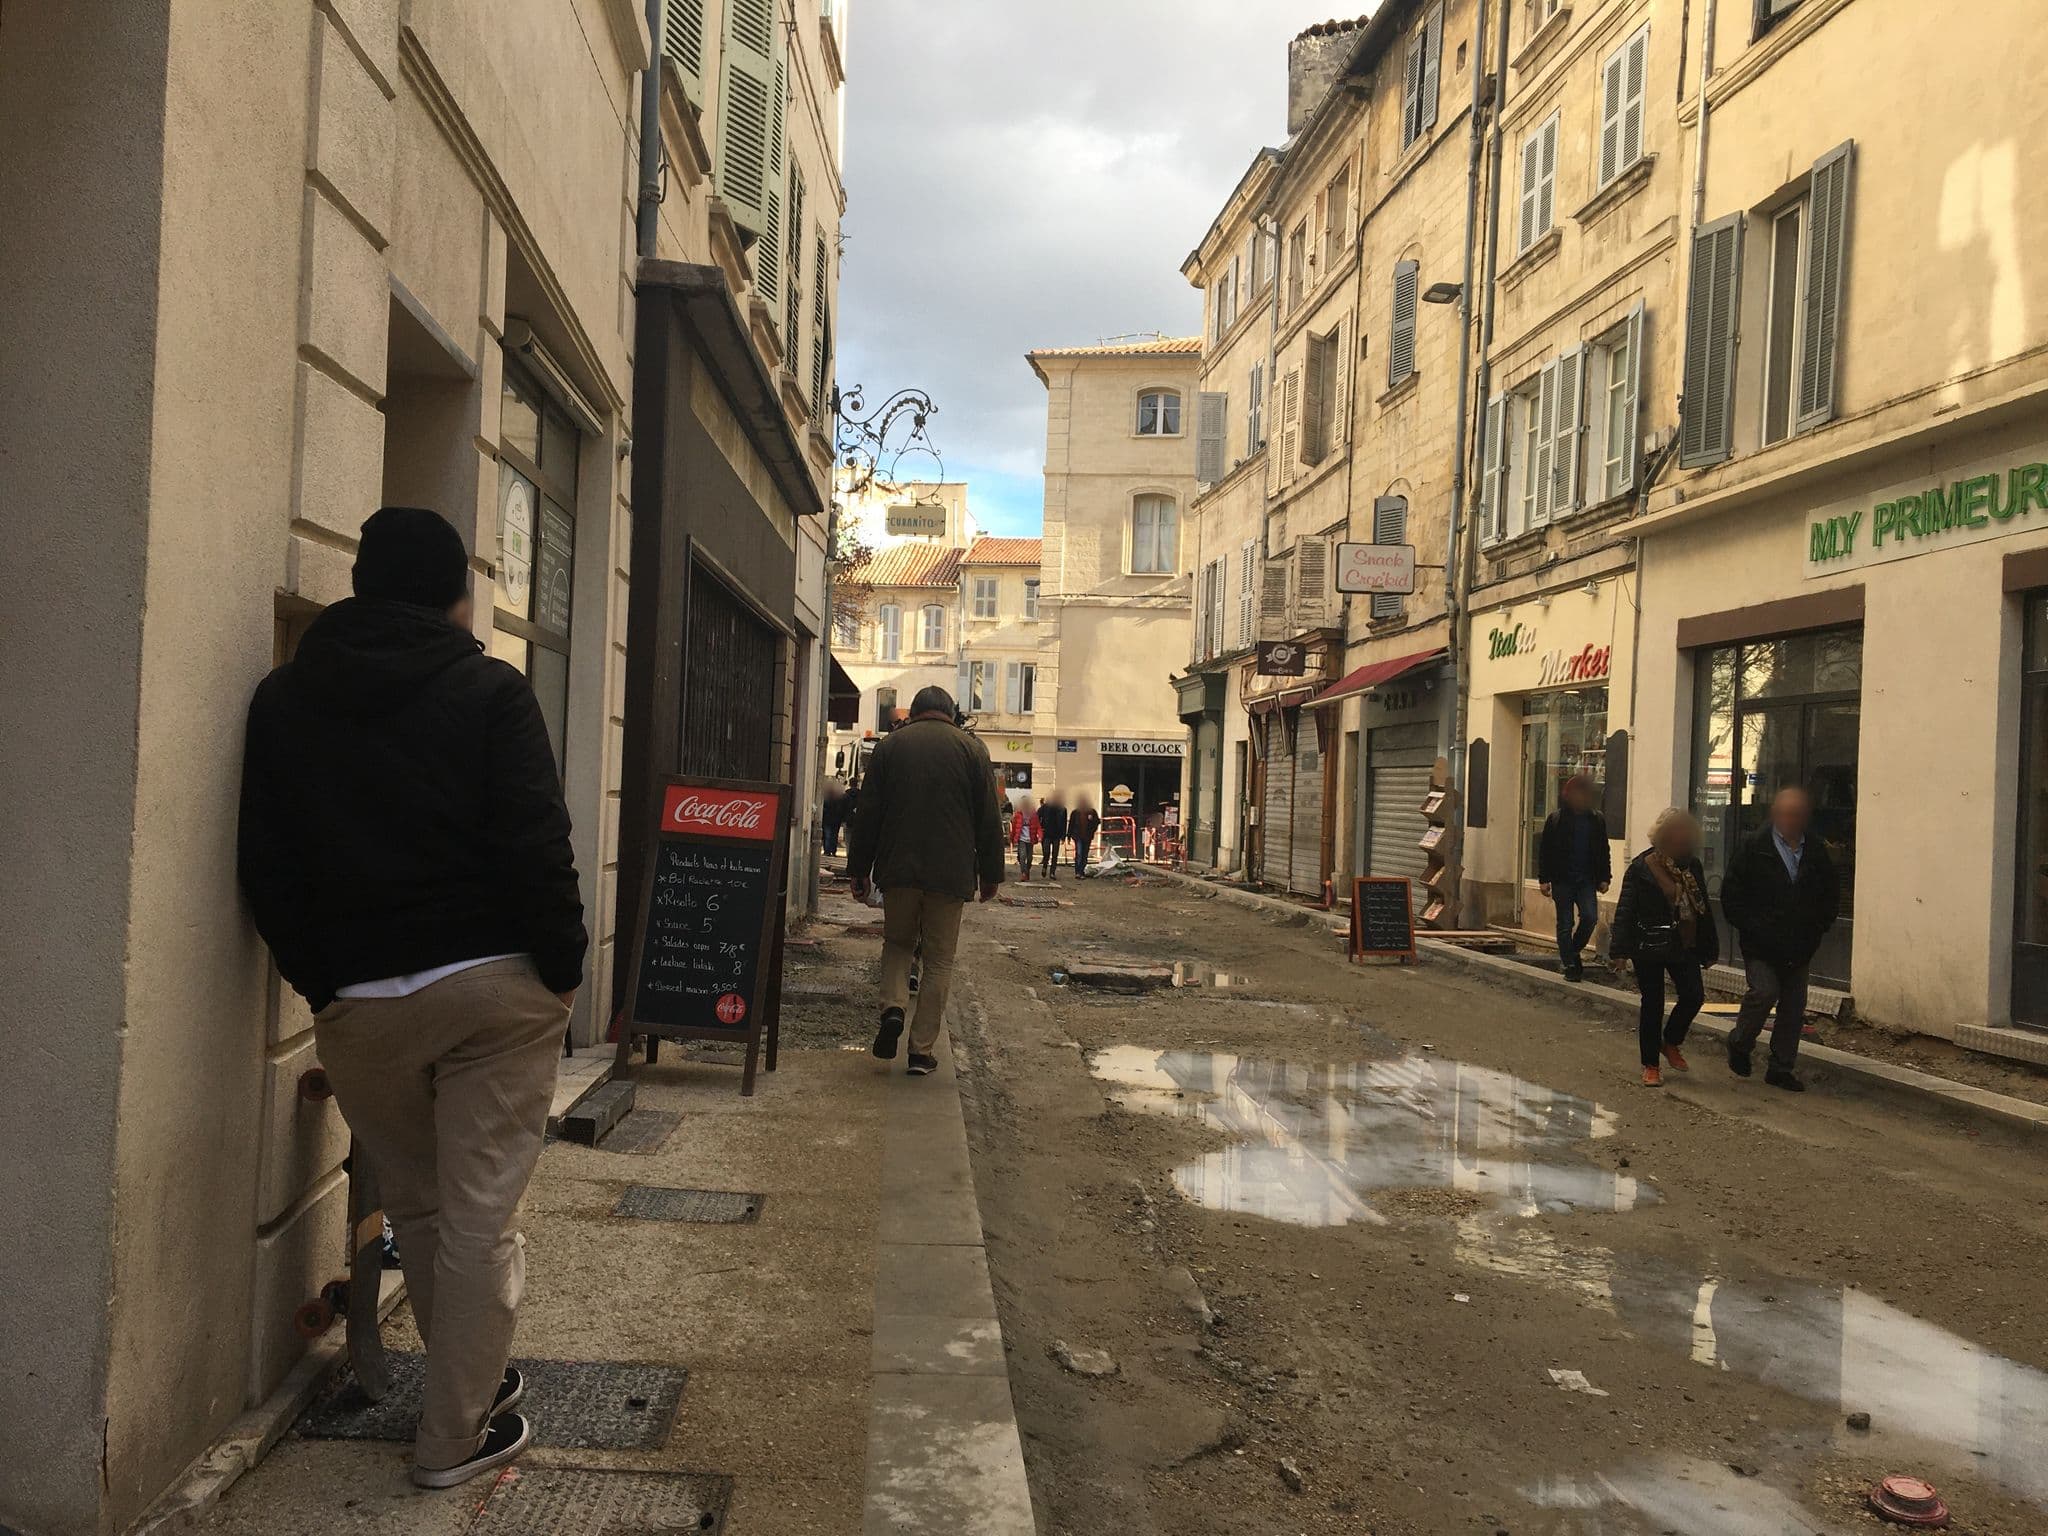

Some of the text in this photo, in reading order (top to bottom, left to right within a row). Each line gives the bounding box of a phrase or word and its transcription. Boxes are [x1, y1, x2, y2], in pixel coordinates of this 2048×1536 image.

[1353, 548, 1404, 567] Snack
[1488, 622, 1537, 661] Italia
[1538, 643, 1610, 686] Market
[1100, 742, 1182, 754] BEER O'CLOCK
[674, 795, 767, 829] Coca-Cola
